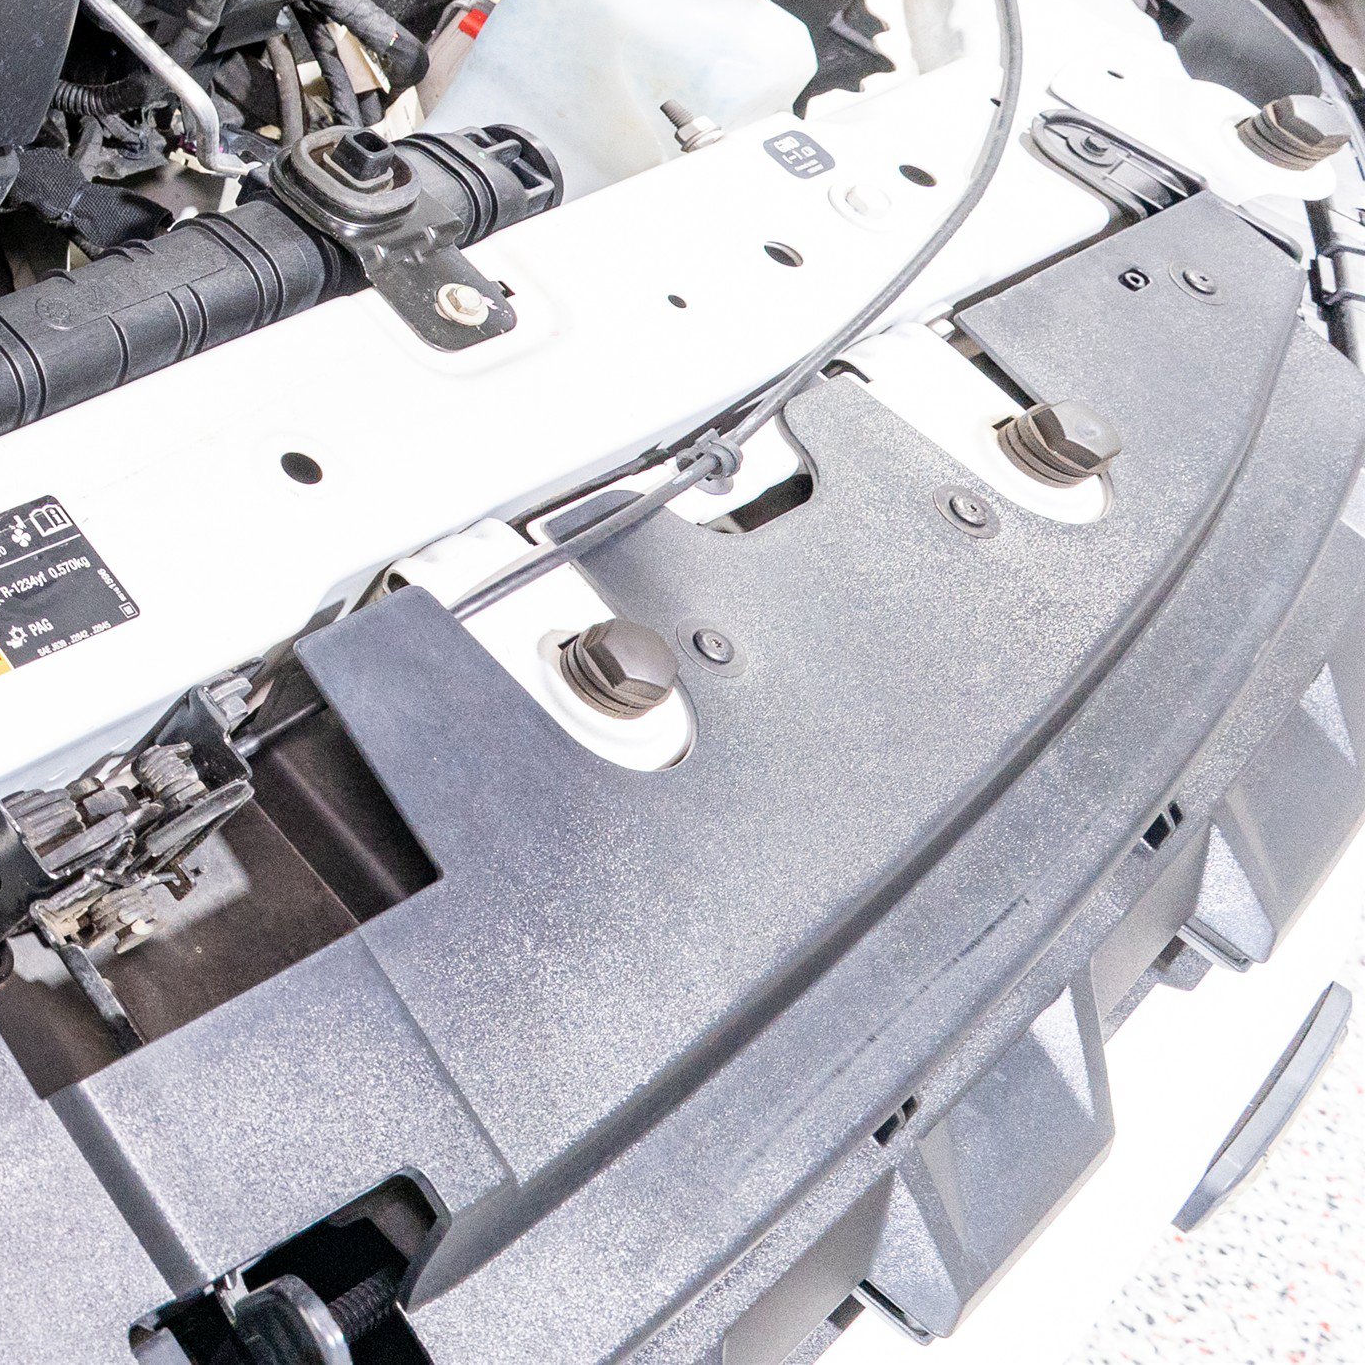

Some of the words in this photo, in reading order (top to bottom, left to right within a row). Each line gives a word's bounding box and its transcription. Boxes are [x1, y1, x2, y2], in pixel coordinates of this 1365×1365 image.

[0, 571, 48, 598] R-1234yf
[47, 556, 91, 580] 0.570kg
[28, 618, 54, 637] PAG
[37, 645, 52, 656] SAE
